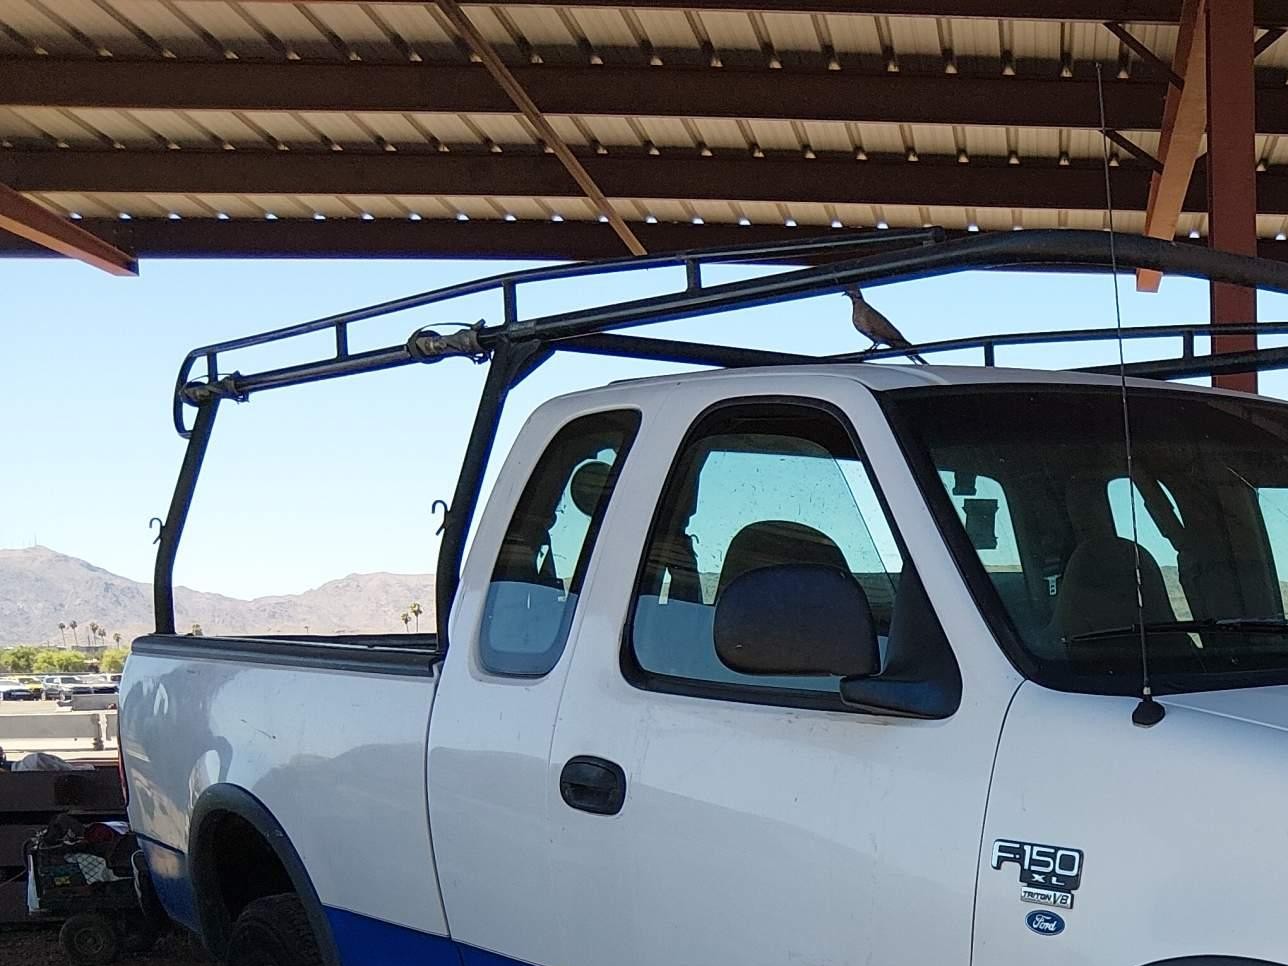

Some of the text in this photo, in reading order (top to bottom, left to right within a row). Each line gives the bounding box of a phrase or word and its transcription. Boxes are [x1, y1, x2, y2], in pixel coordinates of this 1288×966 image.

[1023, 890, 1070, 905] TRITON V8
[1032, 914, 1058, 932] Ford
